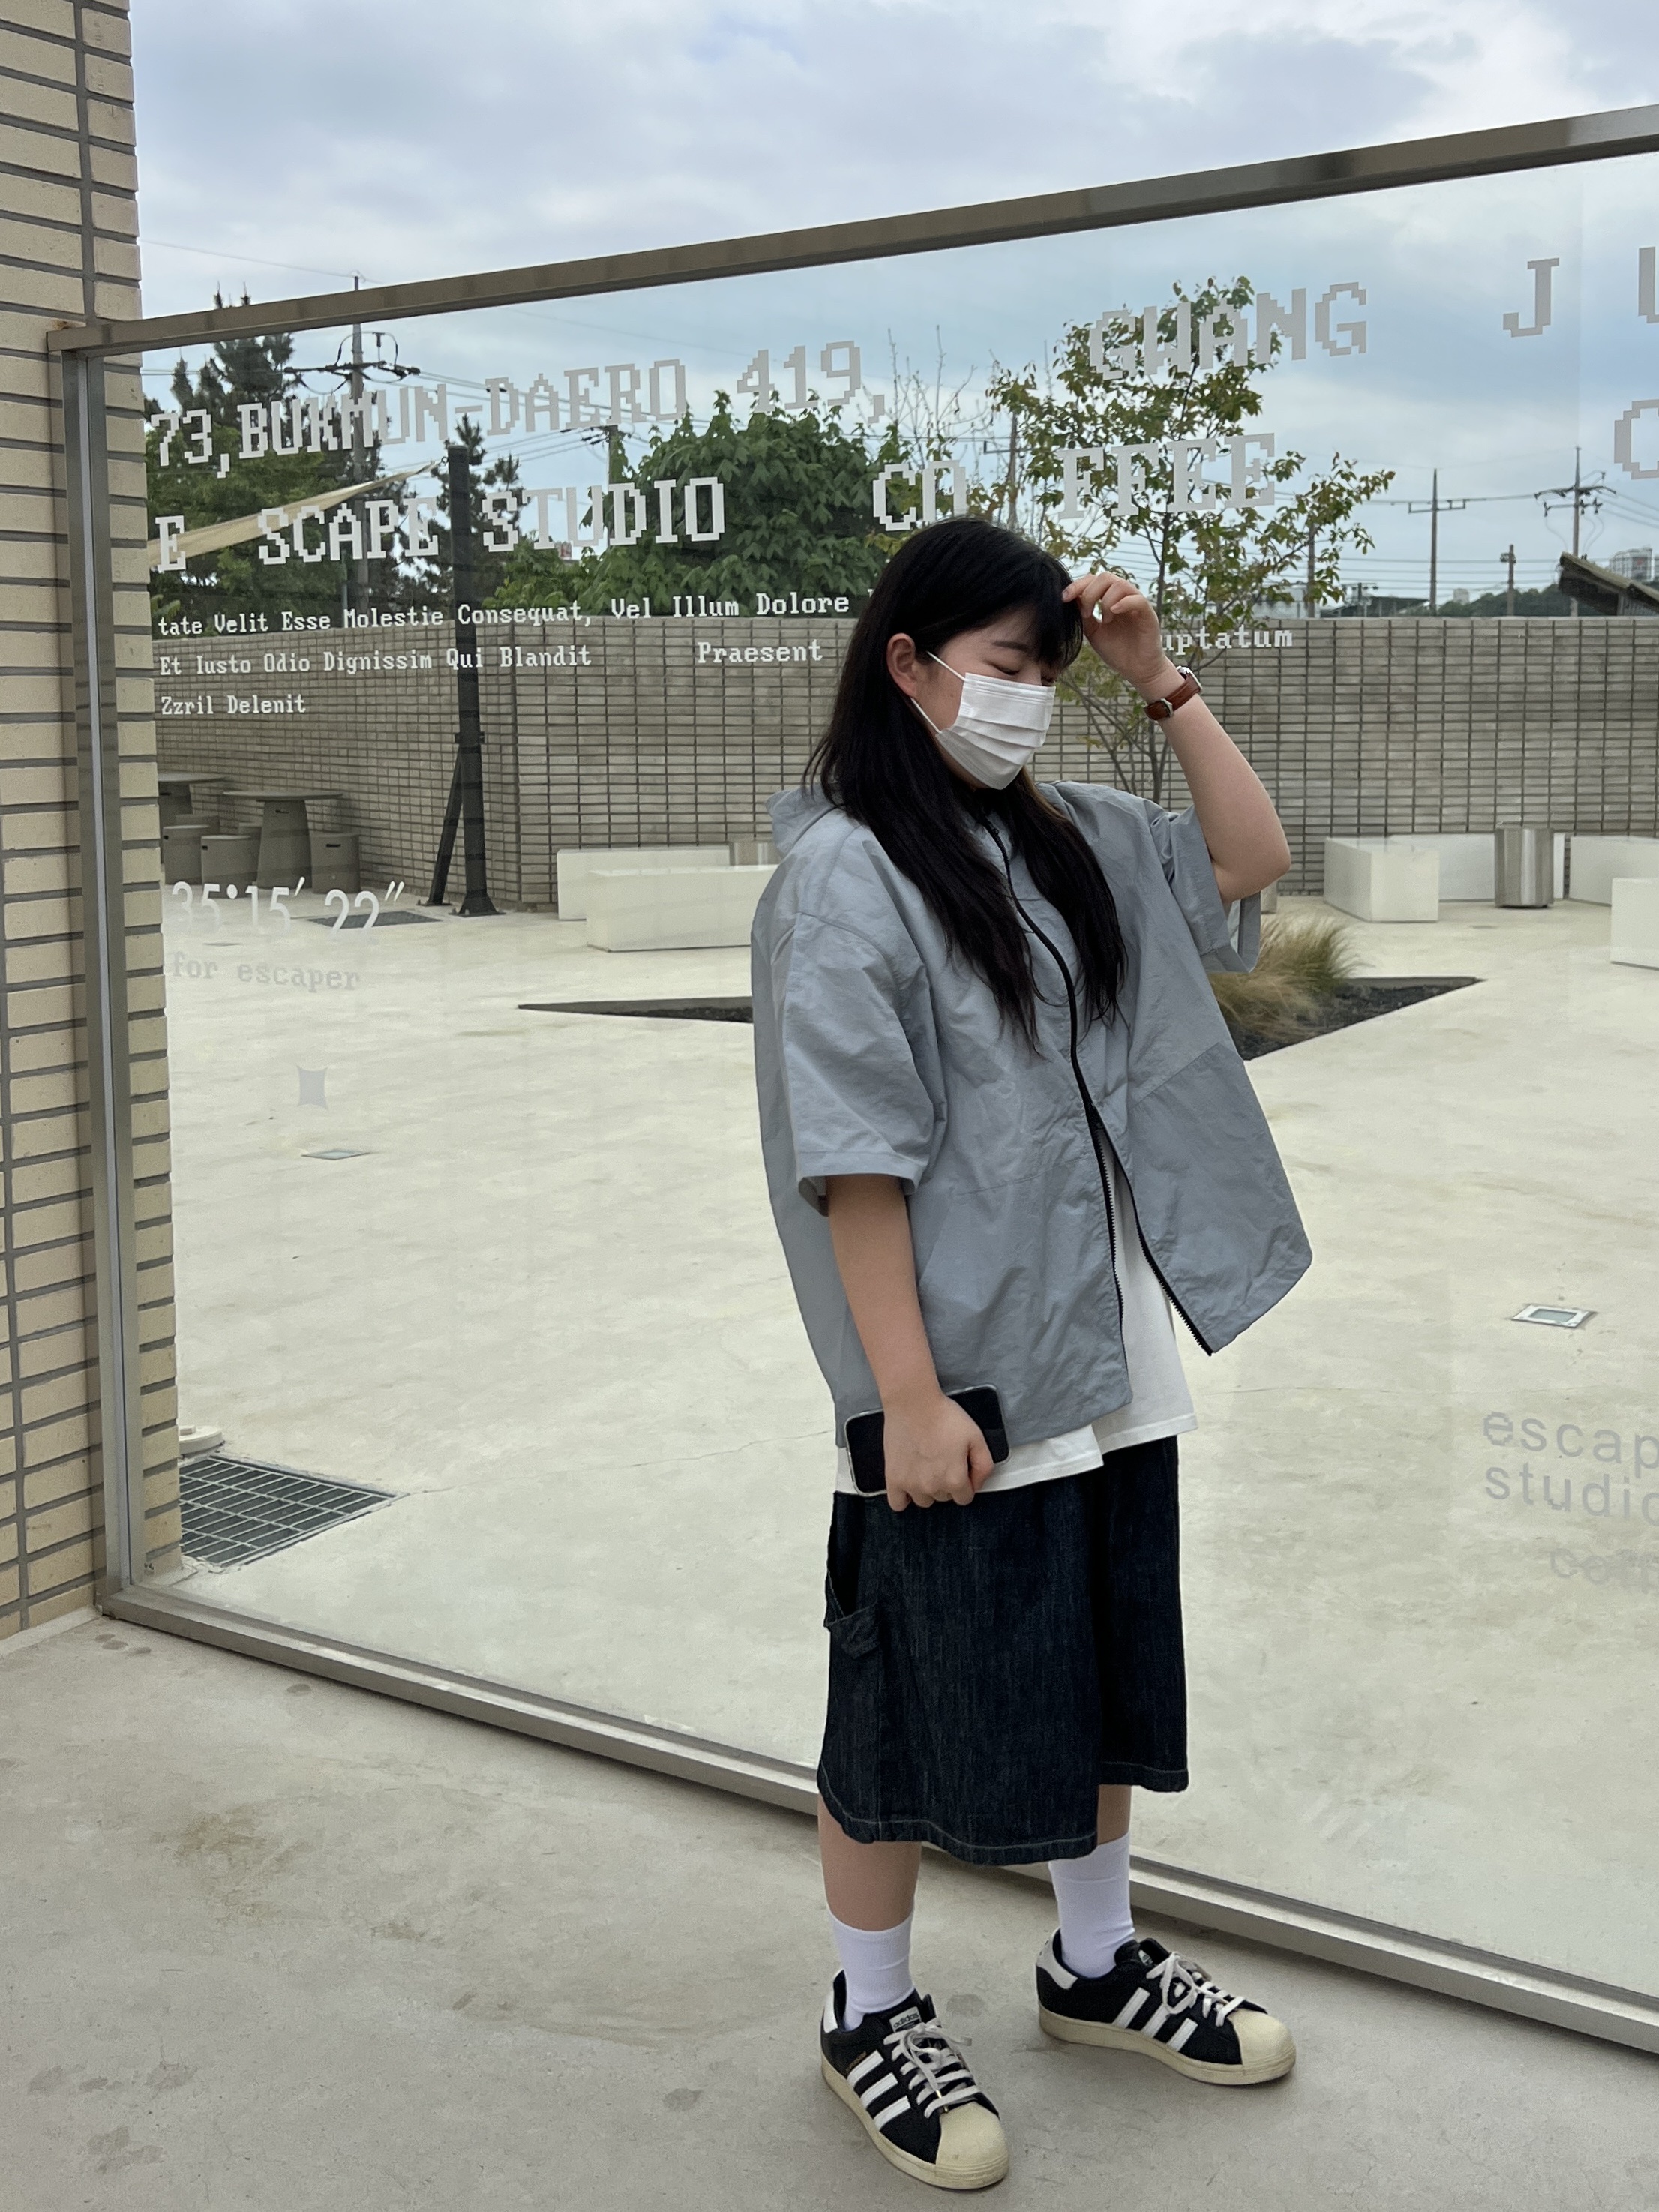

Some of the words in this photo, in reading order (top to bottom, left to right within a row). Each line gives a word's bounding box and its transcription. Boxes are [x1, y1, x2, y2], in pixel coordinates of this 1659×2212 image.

[1503, 257, 1560, 338] J
[736, 340, 885, 424] 419,
[1056, 433, 1275, 519] FFEE
[155, 515, 187, 572] E
[258, 497, 440, 566] SCAPE
[481, 476, 725, 553] STUDIO
[158, 616, 202, 636] tate
[214, 612, 269, 634] Velit
[281, 611, 332, 631] Esse
[343, 606, 444, 629] Molestie
[457, 599, 592, 628] Consequat,
[611, 598, 652, 620] Vel
[672, 596, 740, 618] Illum
[756, 591, 850, 616] Dolore
[160, 656, 182, 677] Et
[196, 653, 252, 675] Iusto
[263, 650, 310, 672] Odio
[323, 648, 432, 675] Dignissim
[446, 647, 484, 670] Qui
[500, 644, 592, 668] Blandit
[698, 639, 824, 664] Praesent
[160, 695, 214, 716] Zzril
[227, 693, 306, 715] Delenit
[170, 950, 218, 980] for
[237, 962, 361, 993] escaper
[1483, 1410, 1659, 1479] escap
[892, 2012, 920, 2028] adidas
